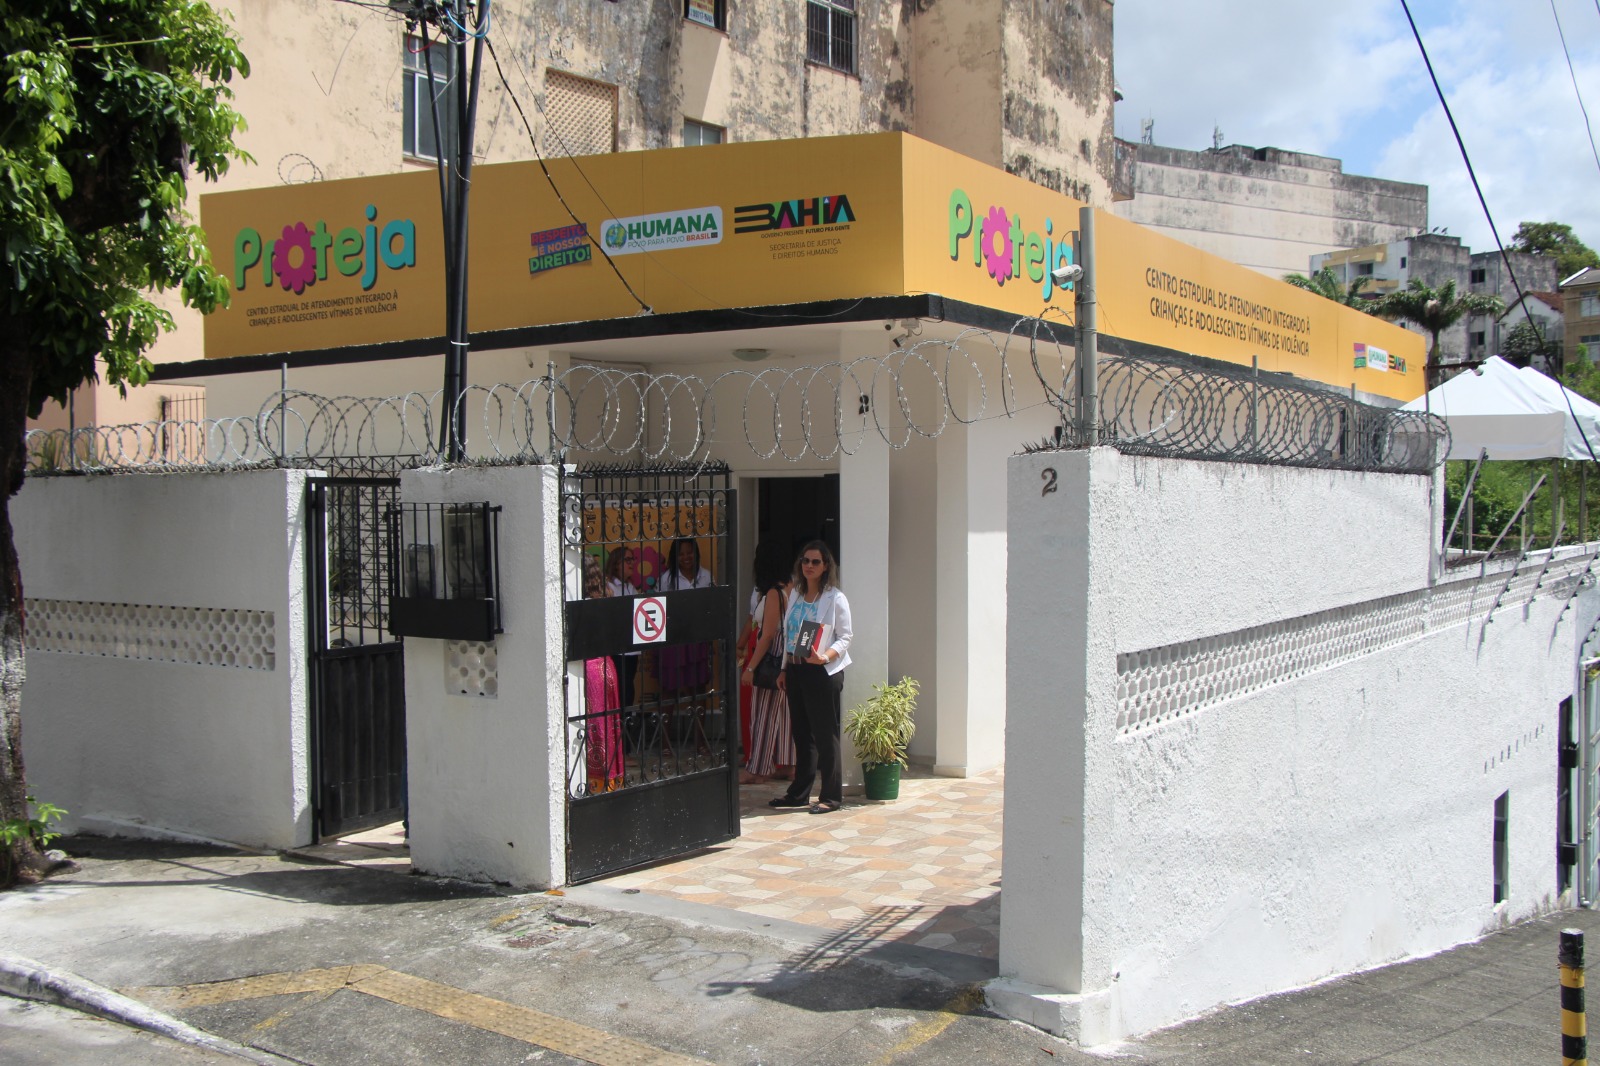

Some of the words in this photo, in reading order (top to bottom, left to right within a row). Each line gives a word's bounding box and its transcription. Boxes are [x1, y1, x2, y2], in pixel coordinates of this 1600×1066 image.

[627, 213, 718, 240] HUMANA
[734, 194, 856, 234] BAHIA
[531, 225, 585, 243] RESPEITO
[539, 244, 545, 255] É
[548, 237, 581, 253] NOSSO
[628, 240, 646, 248] POVO
[648, 238, 665, 246] PARA
[686, 233, 711, 241] BRASIL
[769, 241, 806, 252] SECRETARIA
[817, 238, 842, 247] JUSTIÇA
[948, 188, 1074, 302] Proteja
[234, 203, 416, 295] Proteja
[530, 246, 591, 272] DIREITO!
[778, 251, 805, 259] DIREITOS
[806, 248, 839, 256] HUMANOS
[246, 306, 269, 317] CENTRO
[269, 303, 299, 314] ESTADUAL
[301, 302, 309, 310] DE
[311, 296, 354, 309] ATENDIMENTO
[355, 291, 391, 304] INTEGRADO
[393, 288, 398, 299] À
[1145, 267, 1178, 295] CENTRO
[1179, 279, 1217, 307] ESTADUAL
[1218, 291, 1227, 310] DE
[1229, 295, 1272, 324] ATENDIMENTO
[1273, 310, 1305, 333] INTEGRADO
[1306, 315, 1311, 335] À
[249, 316, 276, 327] CRIANÇAS
[277, 316, 281, 324] E
[282, 311, 328, 323] ADOLESCENTES
[330, 307, 353, 318] VÍTIMAS
[354, 307, 363, 316] DE
[364, 302, 397, 314] VIOLÊNCIA
[1150, 297, 1187, 328] CRIANÇAS
[1189, 309, 1193, 327] E
[1195, 310, 1246, 341] ADOLESCENTES
[1248, 322, 1271, 348] VÍTIMAS
[1272, 332, 1279, 350] DE
[1281, 334, 1310, 357] VIOLÊNCIA
[1041, 467, 1057, 497] 2
[645, 610, 656, 631] E
